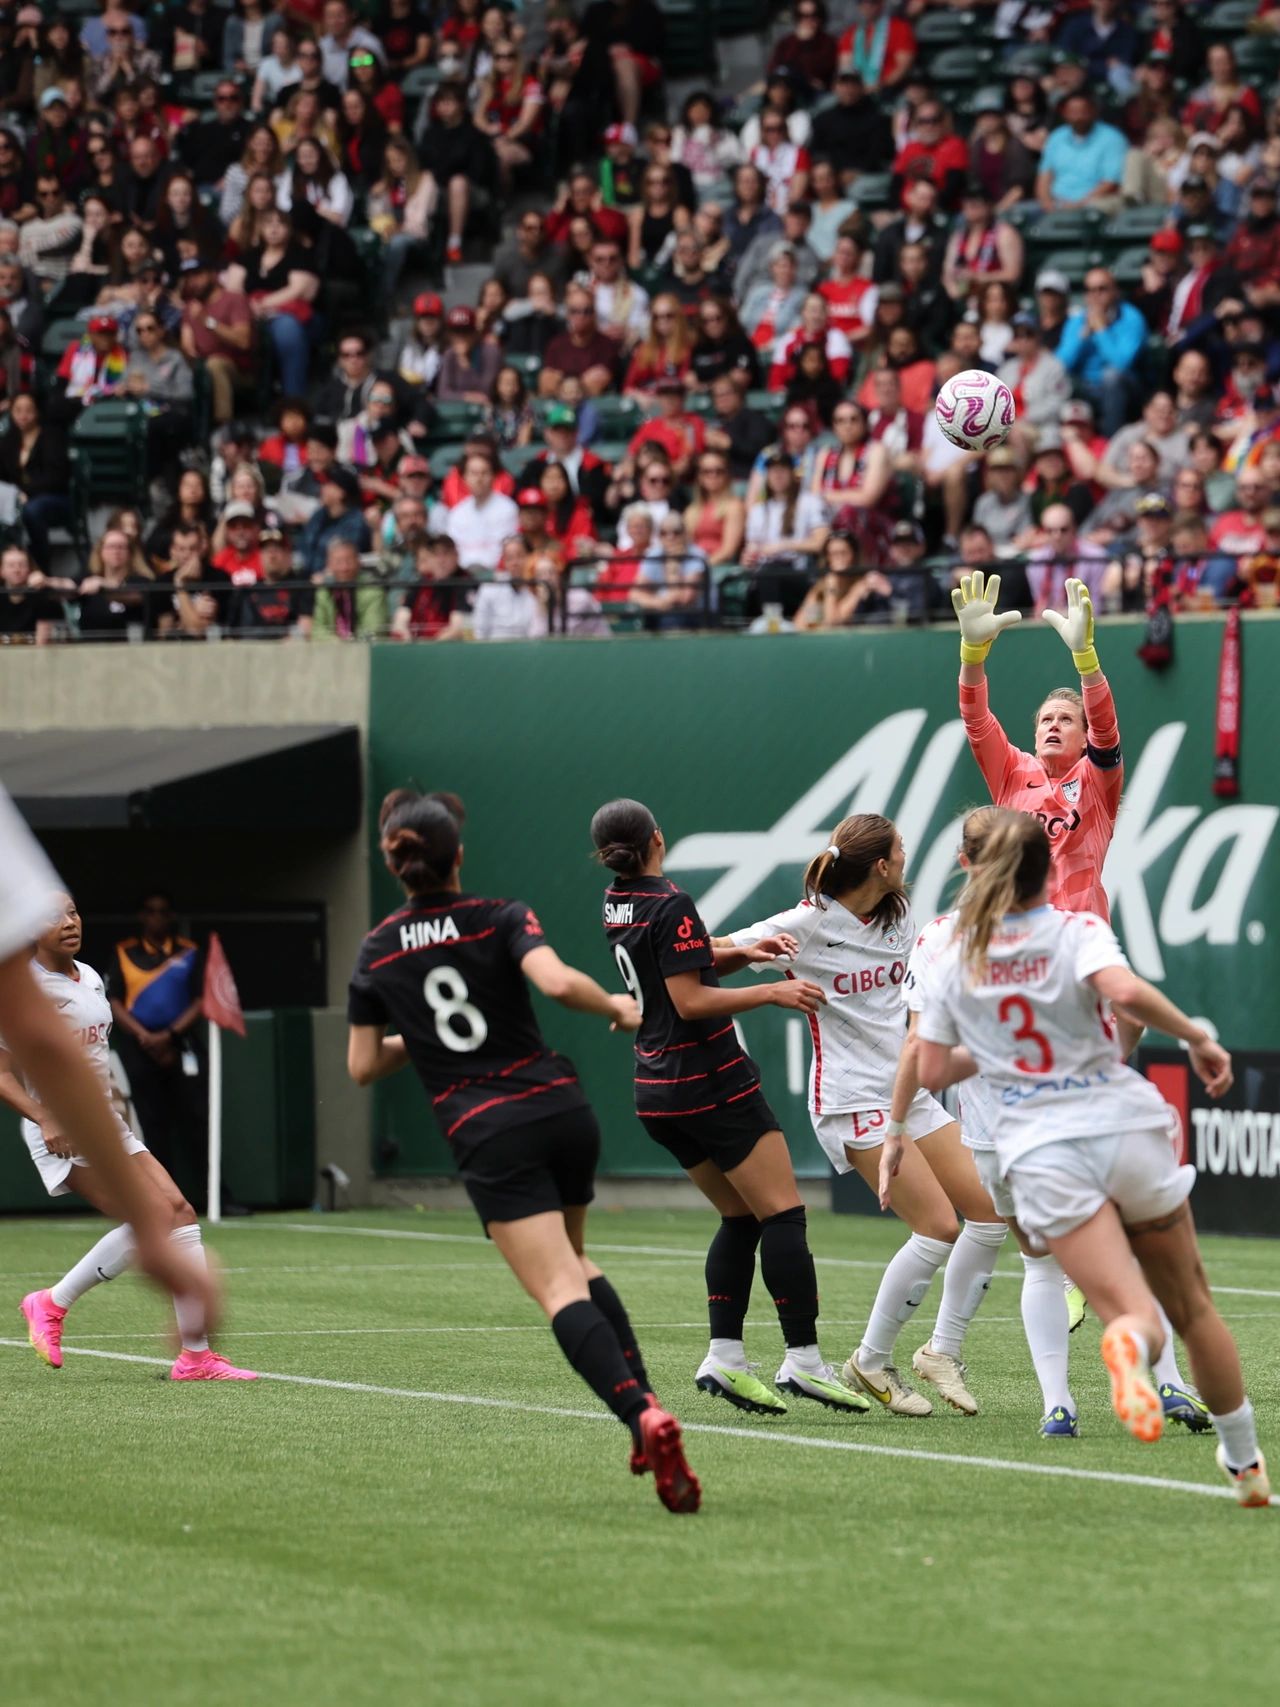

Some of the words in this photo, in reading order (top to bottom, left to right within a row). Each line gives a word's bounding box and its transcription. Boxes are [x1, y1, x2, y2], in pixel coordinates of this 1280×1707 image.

[604, 903, 634, 924] SMITH
[399, 915, 461, 951] HINA
[673, 938, 705, 953] TikTok
[615, 943, 645, 1015] 9
[833, 965, 886, 995] CIBC
[971, 955, 1048, 987] RIGHT
[423, 965, 488, 1052] 8
[998, 994, 1055, 1074] 3
